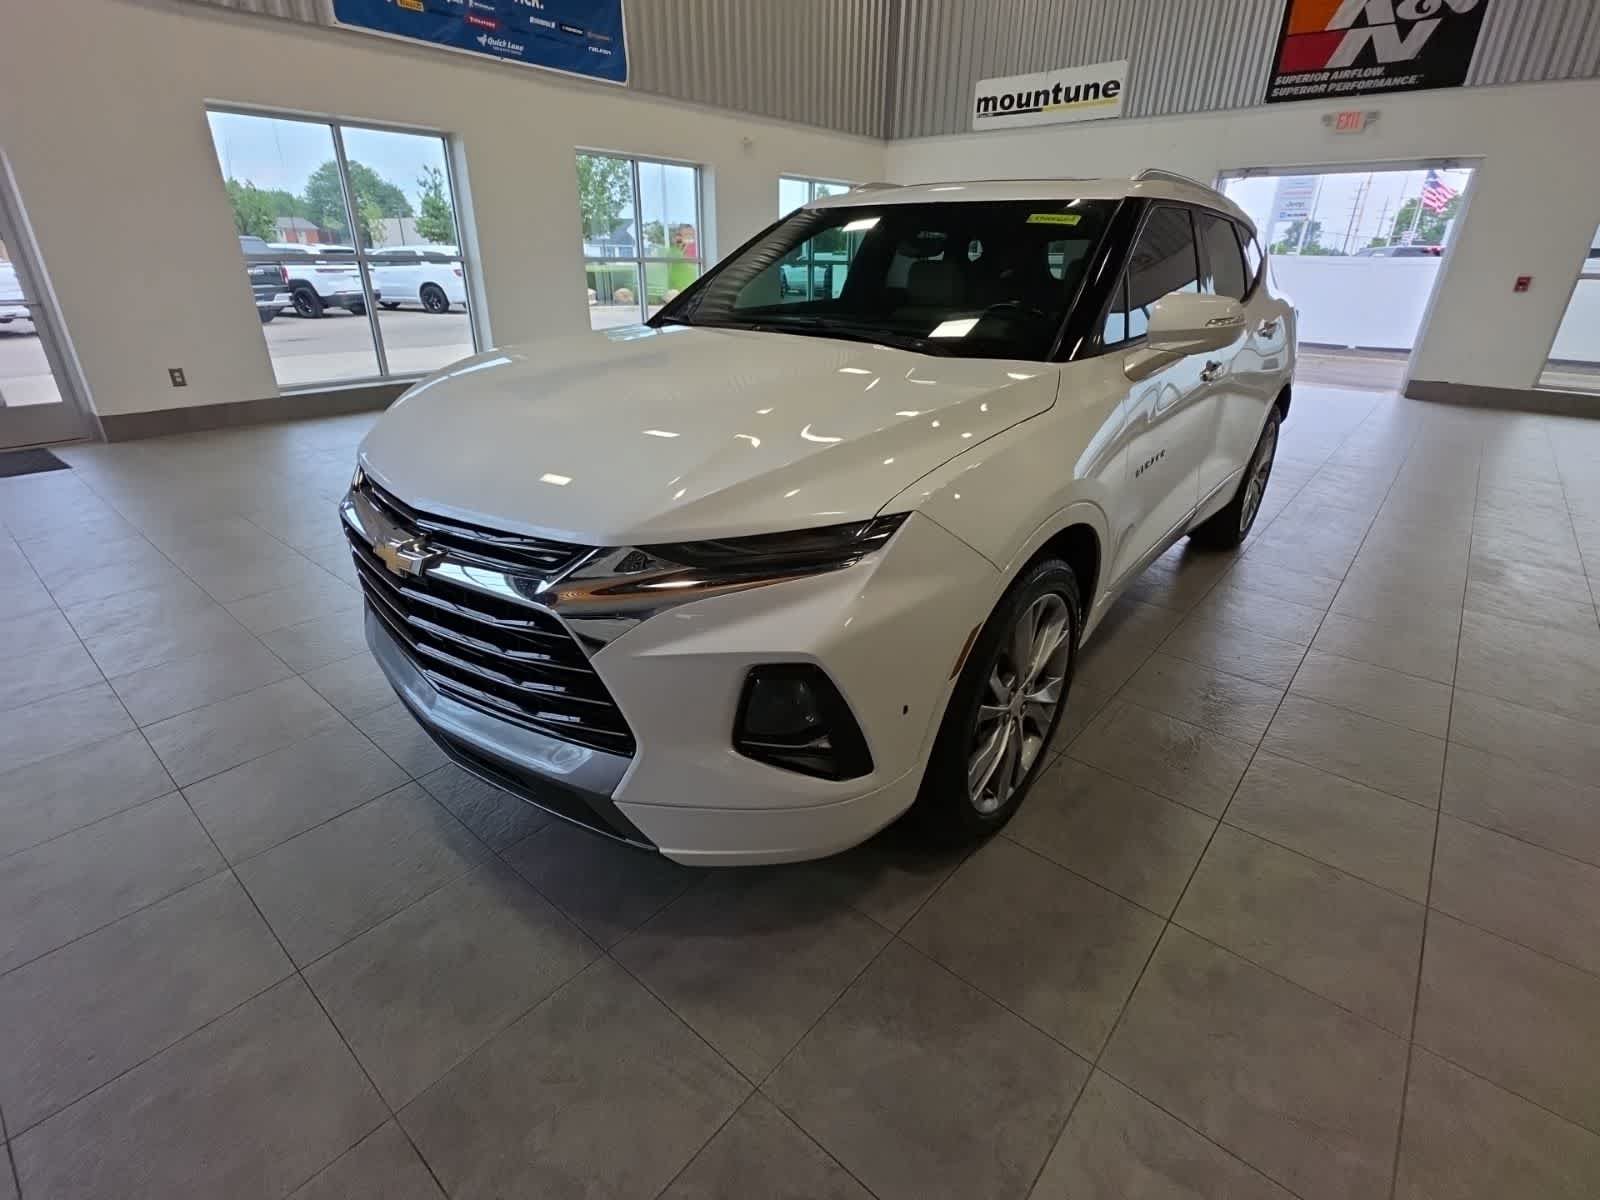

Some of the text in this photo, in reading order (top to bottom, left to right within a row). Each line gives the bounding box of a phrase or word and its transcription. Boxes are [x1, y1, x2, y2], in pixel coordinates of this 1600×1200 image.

[487, 36, 507, 48] Quick
[1274, 66, 1385, 86] SUPERIOR AIRFLOW.
[976, 79, 1121, 114] mountune
[1271, 83, 1328, 97] SUPERIOR
[1336, 111, 1362, 130] EXIT
